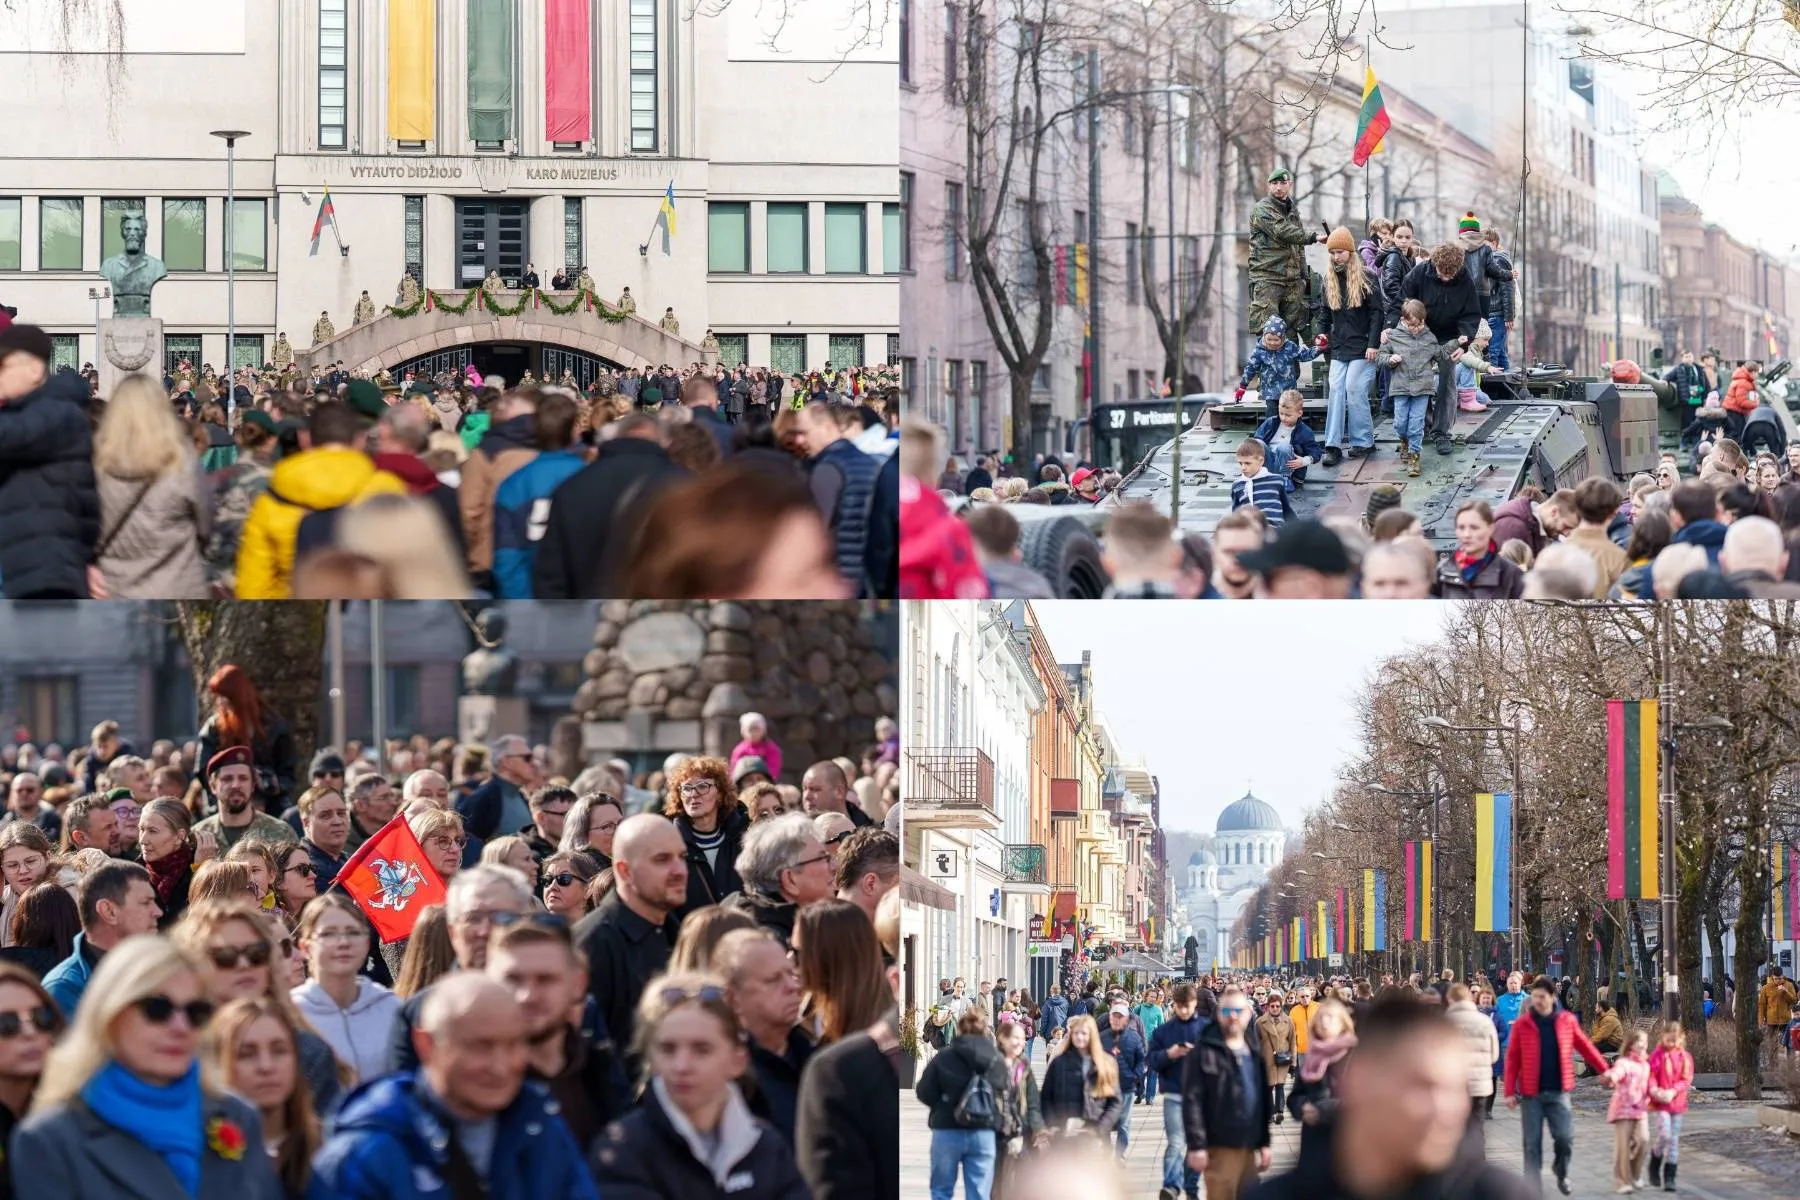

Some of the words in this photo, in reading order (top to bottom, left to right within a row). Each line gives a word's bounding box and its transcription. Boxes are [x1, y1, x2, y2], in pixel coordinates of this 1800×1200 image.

[350, 166, 404, 179] VYTAUTO
[407, 164, 462, 179] DIDŽIOJO
[526, 168, 558, 180] KARO
[561, 168, 618, 181] MUZIEJUS
[1110, 410, 1126, 429] 37
